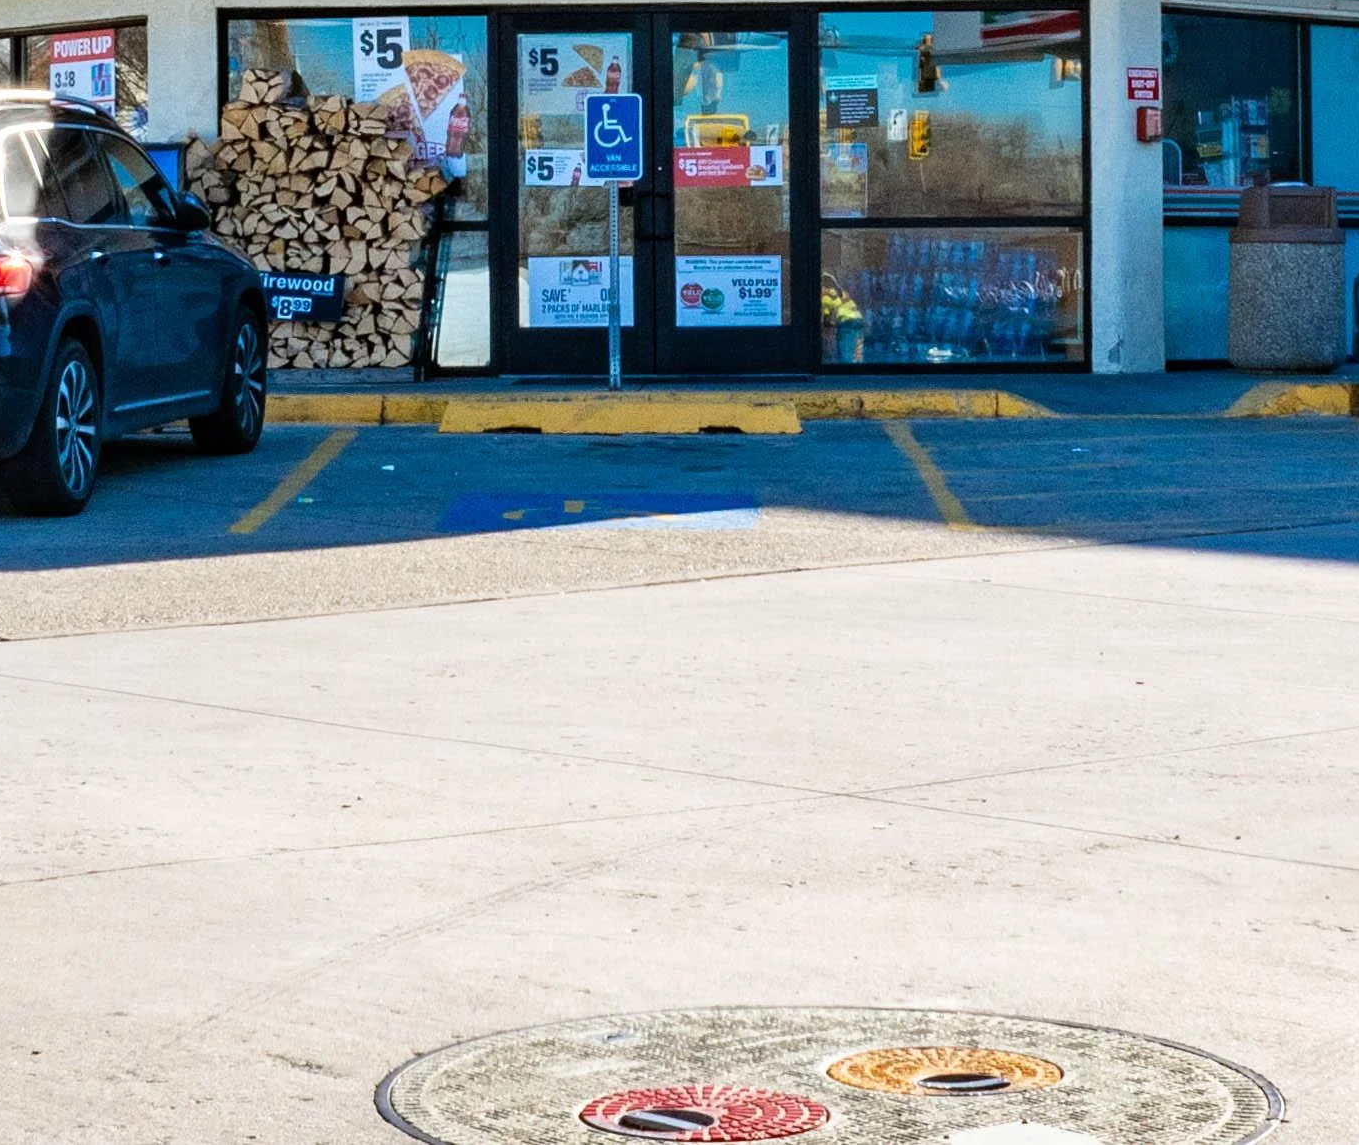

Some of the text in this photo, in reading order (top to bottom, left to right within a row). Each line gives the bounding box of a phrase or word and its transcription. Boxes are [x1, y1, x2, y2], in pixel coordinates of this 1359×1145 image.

[53, 36, 112, 58] POWER UP
[360, 28, 404, 70] $5
[528, 47, 559, 76] $5
[606, 154, 622, 162] VAN
[527, 156, 554, 181] $5
[590, 164, 637, 172] ACCESSIBLE
[678, 158, 698, 177] $5
[259, 273, 335, 292] irewood
[731, 278, 778, 287] VELO PLUS
[541, 288, 567, 303] SAVE
[738, 287, 772, 300] $1.99
[542, 304, 547, 314] 2
[547, 304, 570, 313] PACKS
[571, 303, 578, 312] OF
